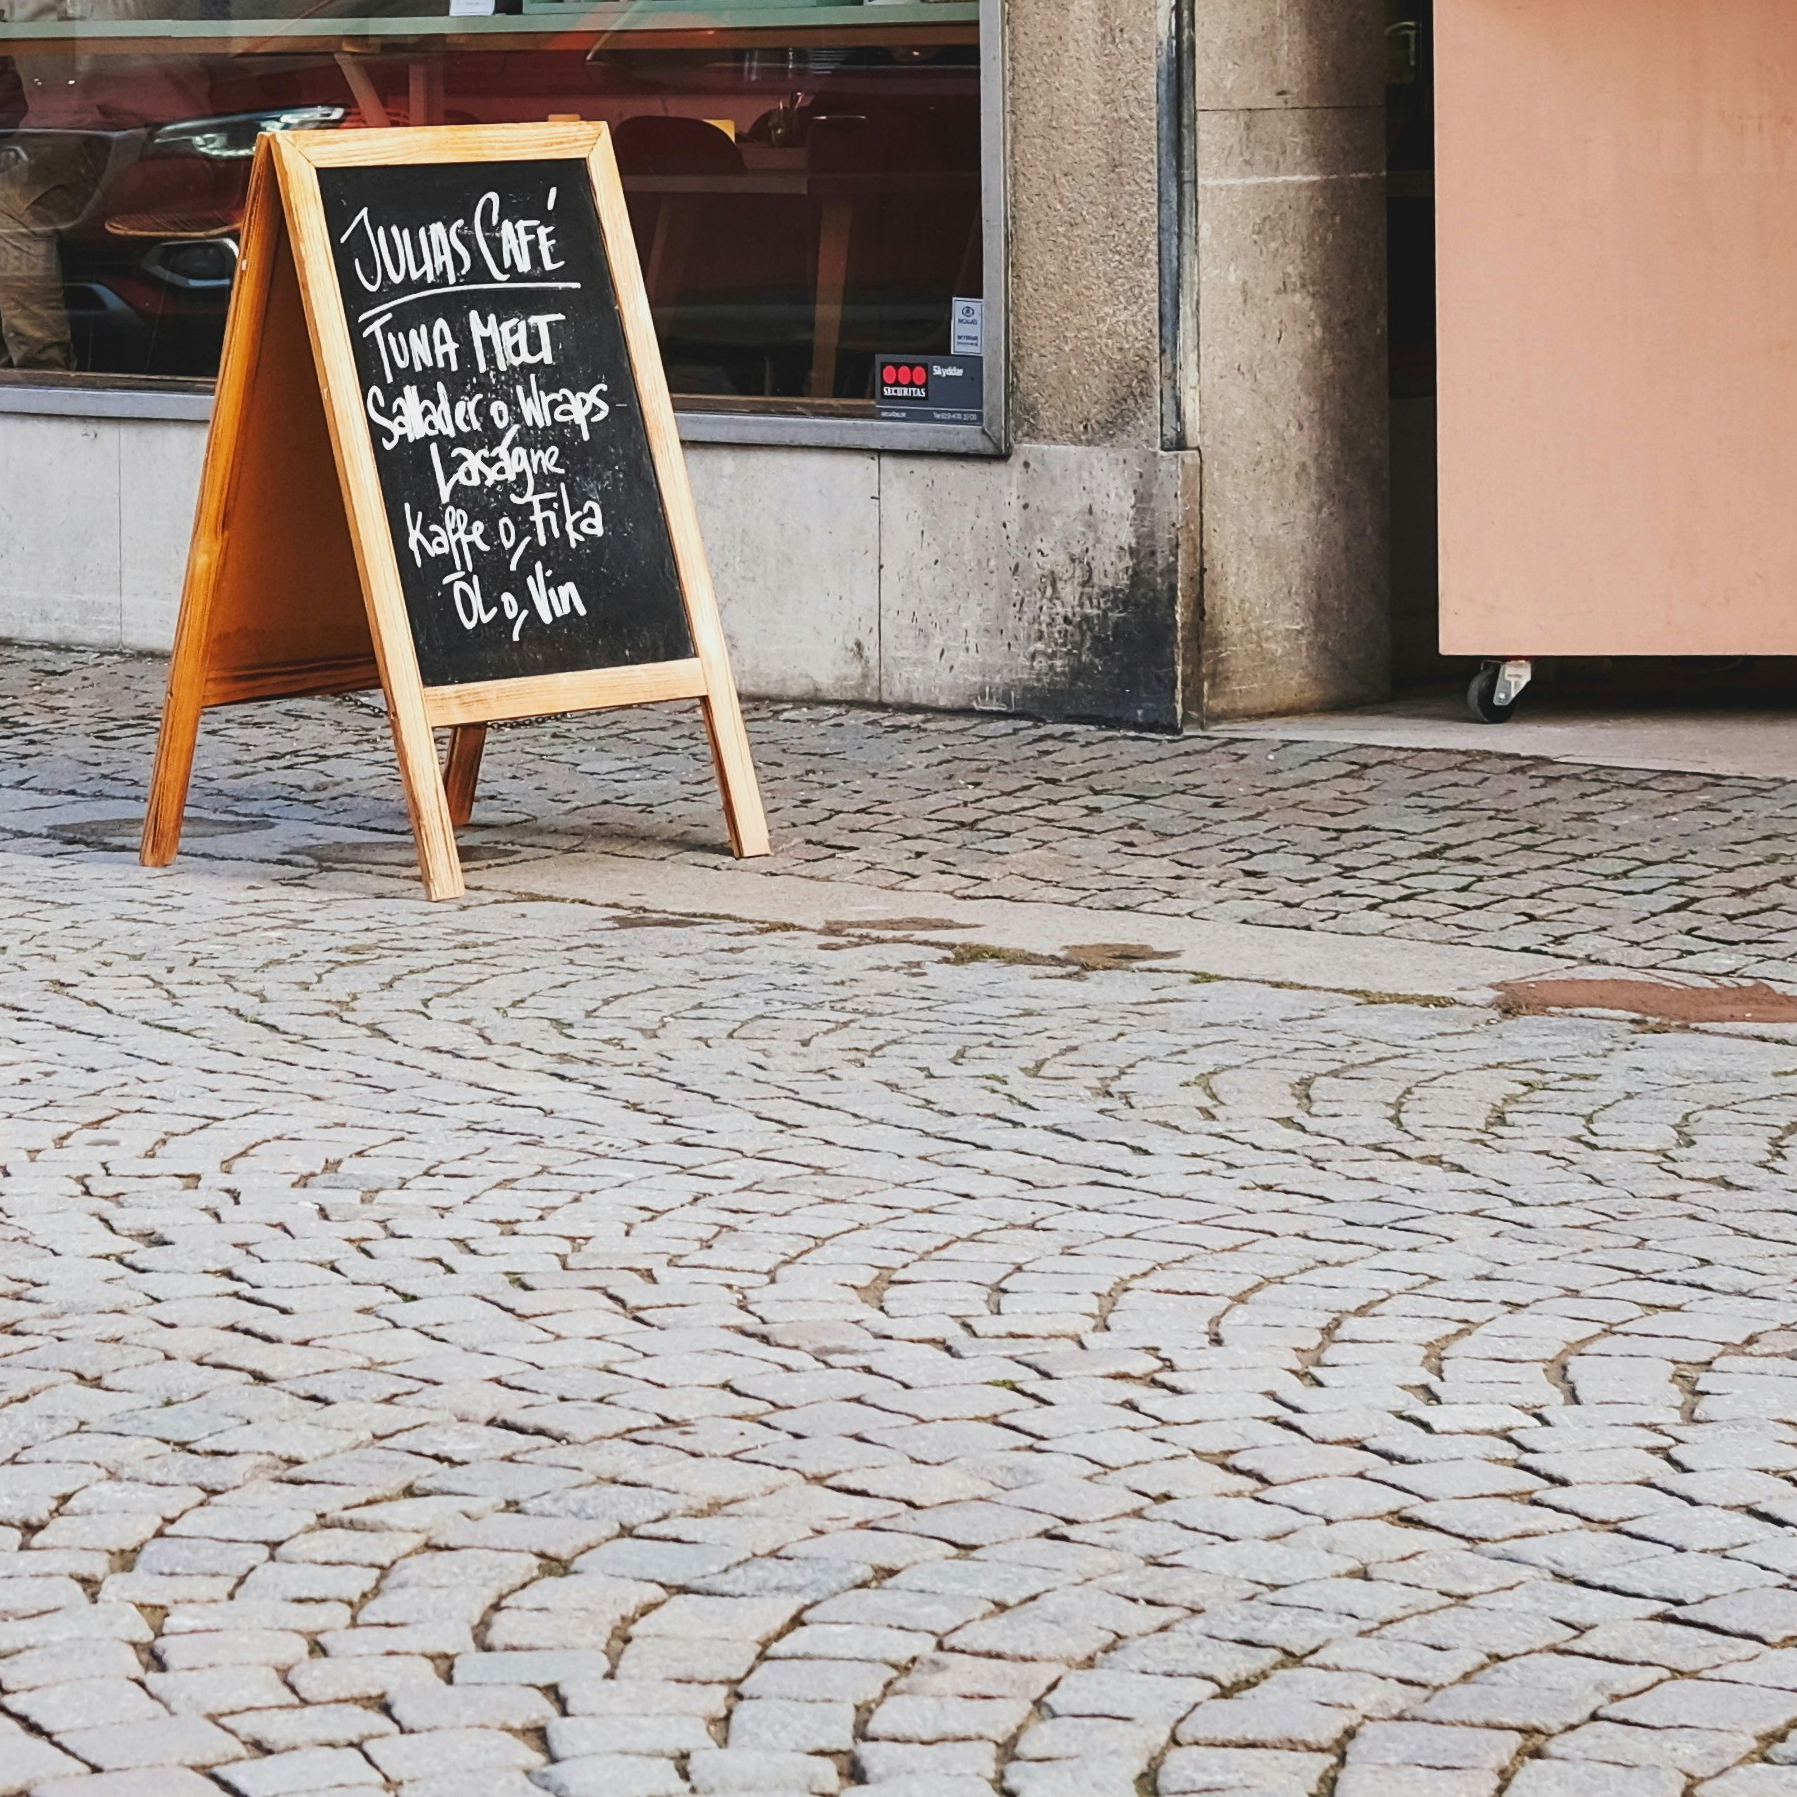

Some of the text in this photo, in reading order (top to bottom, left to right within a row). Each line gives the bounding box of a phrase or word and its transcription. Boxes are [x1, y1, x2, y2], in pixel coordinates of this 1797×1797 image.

[340, 186, 566, 292] JULIAS CAFÉ
[362, 309, 566, 383] TUNA MELT
[932, 365, 964, 378] Skyddar
[367, 381, 484, 451] Sallader
[515, 373, 610, 441] Wraps
[882, 386, 926, 398] SECURITAS
[404, 502, 491, 573] Kaffe
[529, 481, 604, 549] Fika
[526, 560, 587, 625] Vin
